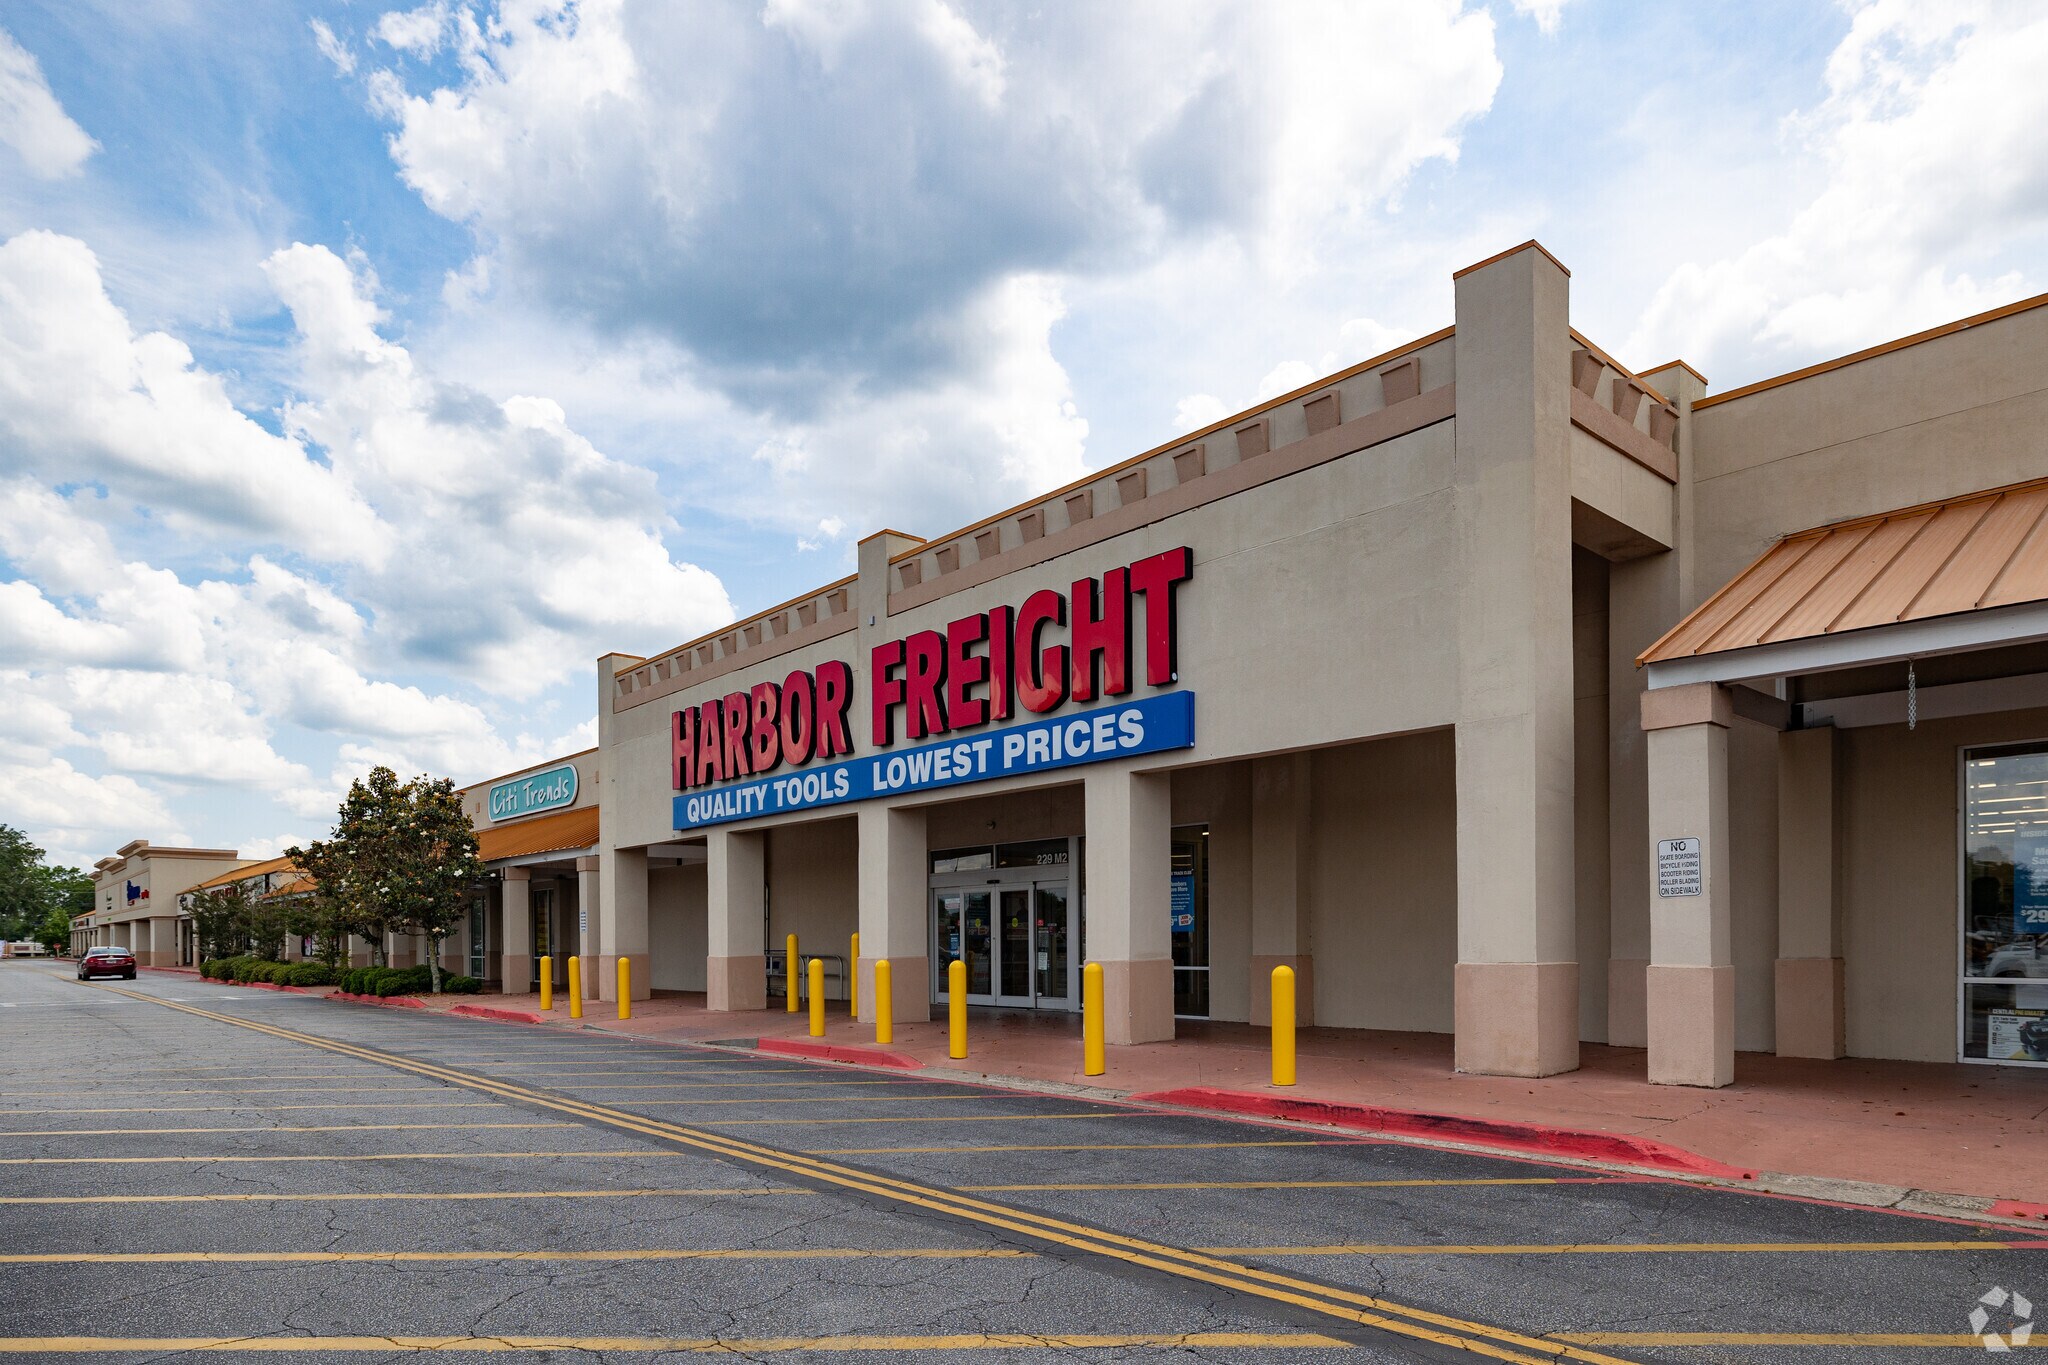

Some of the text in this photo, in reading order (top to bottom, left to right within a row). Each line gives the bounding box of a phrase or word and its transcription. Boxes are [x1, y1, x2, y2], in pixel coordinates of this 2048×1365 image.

[672, 546, 1193, 790] HARBOR FREIGHT
[872, 709, 1144, 791] LOWEST PRICES
[493, 777, 570, 815] Citi Trends
[687, 767, 850, 824] QUALITY TOOLS
[1670, 841, 1687, 852] NO
[1036, 852, 1068, 865] 229 M2
[1674, 852, 1698, 860] BOARDING
[1661, 870, 1682, 878] SCOOTER
[1679, 877, 1699, 885] BLADING
[1670, 886, 1699, 895] SIDEWALK
